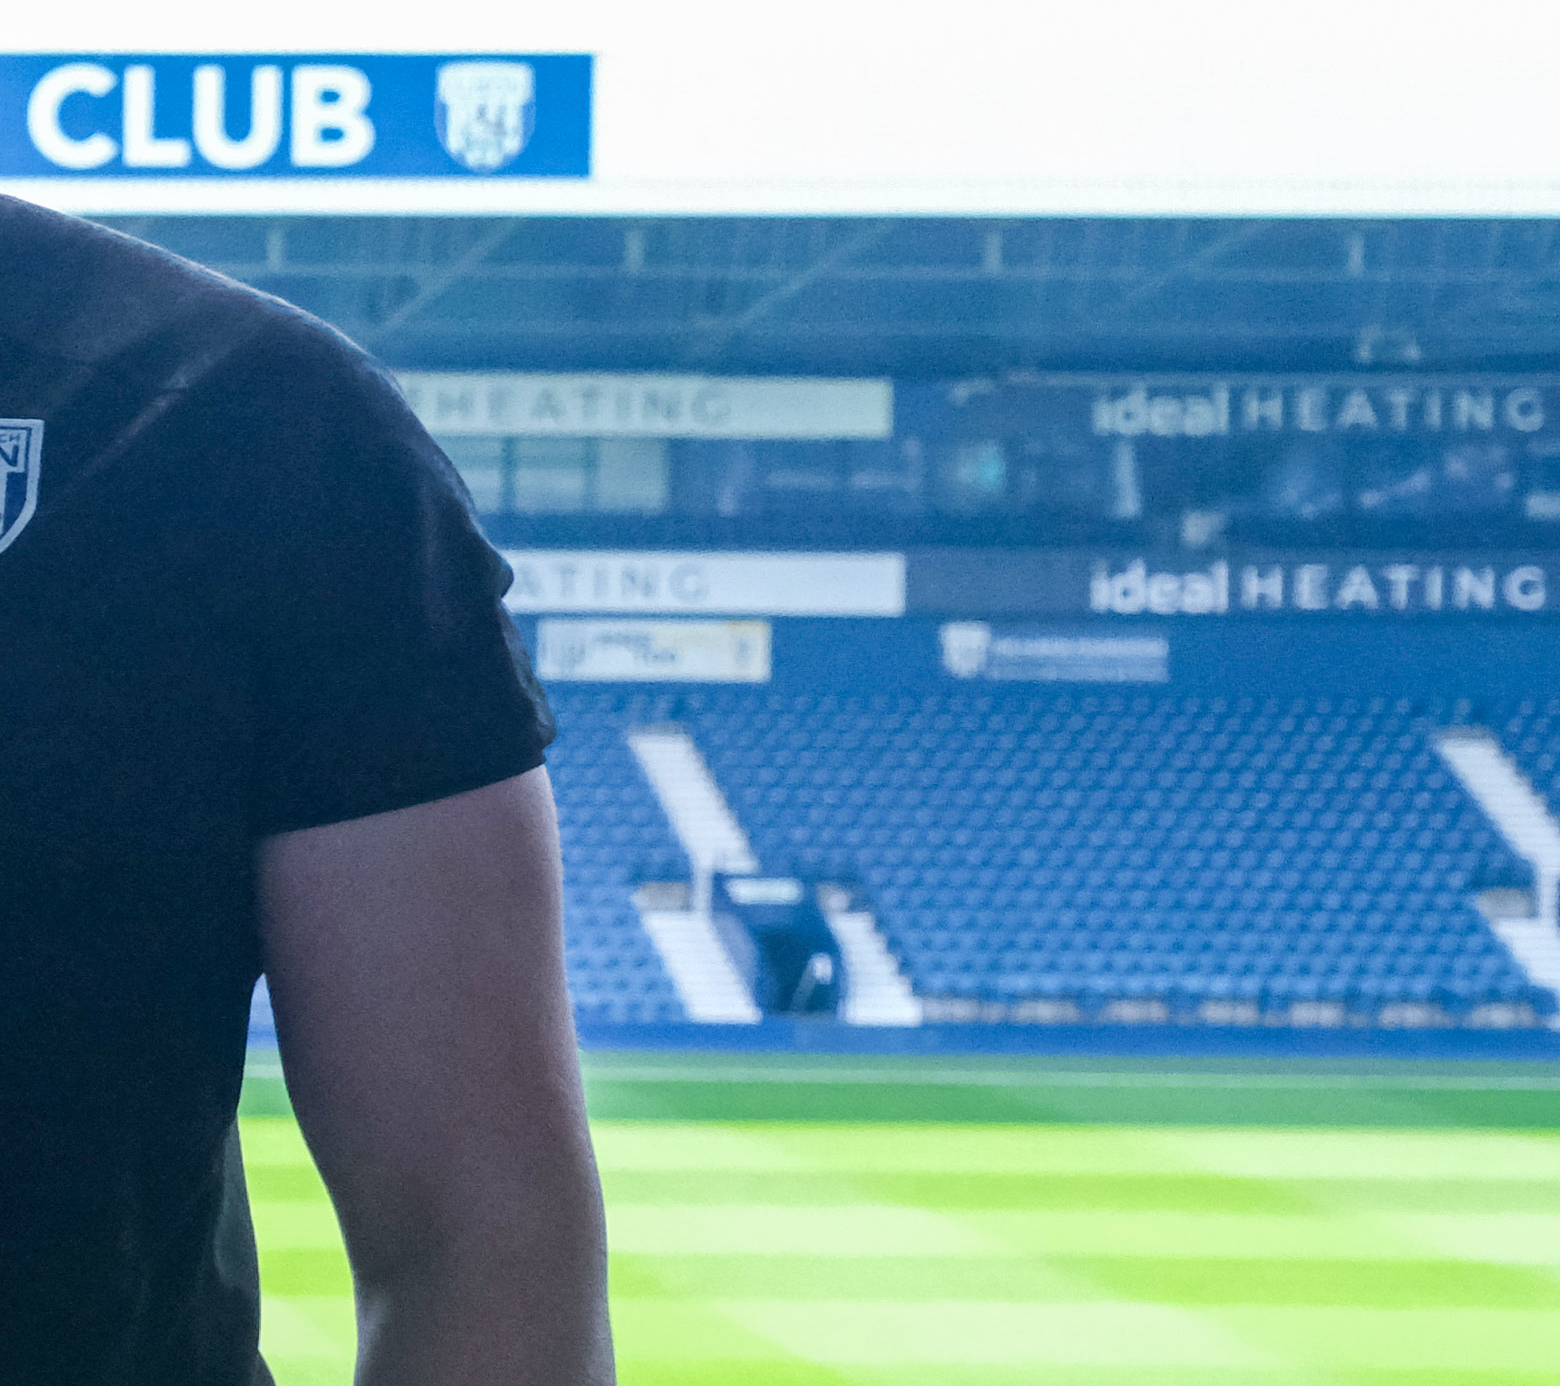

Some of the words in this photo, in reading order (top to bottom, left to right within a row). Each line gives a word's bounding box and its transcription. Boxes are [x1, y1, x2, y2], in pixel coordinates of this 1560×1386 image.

[26, 61, 377, 170] CLUB
[1242, 387, 1547, 433] HEATING
[512, 562, 711, 605] ATING
[1241, 564, 1547, 612] HEATING
